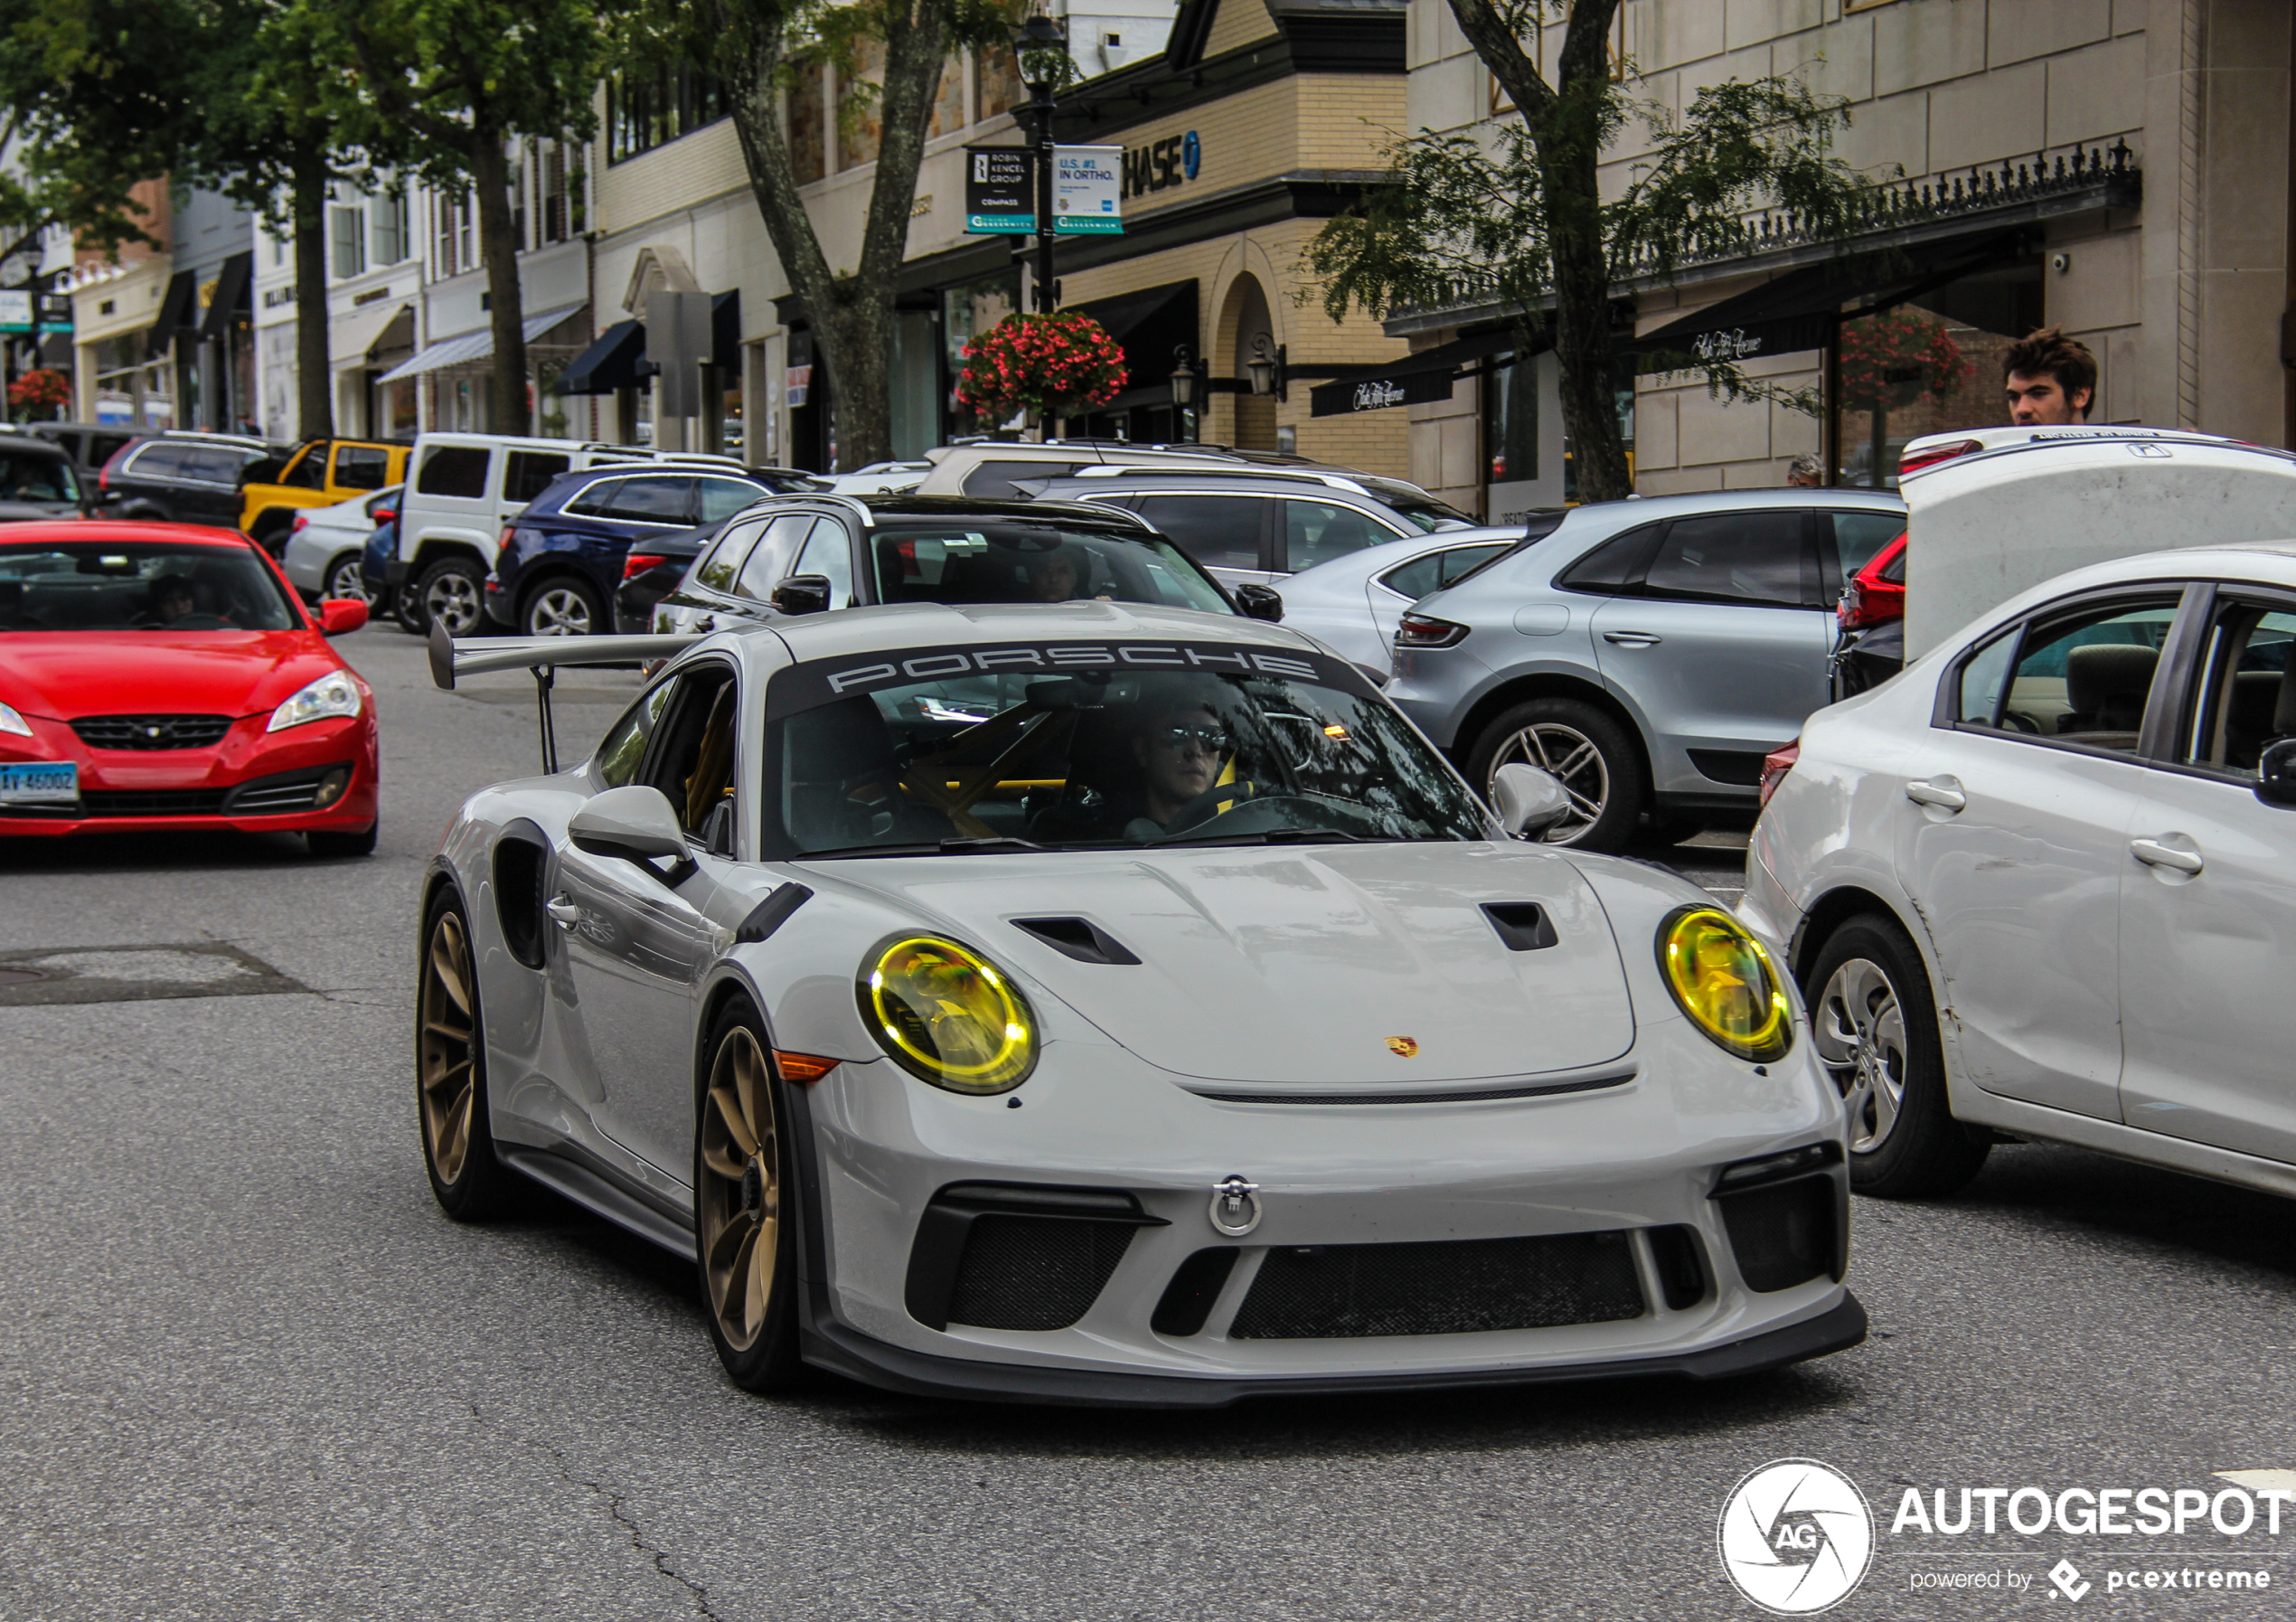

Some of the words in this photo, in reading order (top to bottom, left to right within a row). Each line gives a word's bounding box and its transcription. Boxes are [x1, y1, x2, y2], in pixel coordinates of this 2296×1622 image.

[992, 154, 1021, 162] ROBIN
[1059, 158, 1080, 169] U.S.
[1083, 159, 1096, 169] #1
[1120, 135, 1182, 201] HASE
[991, 165, 1025, 173] KENCEL
[990, 174, 1022, 184] GROUP
[1059, 170, 1071, 180] IN
[1073, 169, 1114, 181] ORTHO.
[981, 198, 1020, 206] COMPASS
[826, 646, 1320, 694] PORSCHE
